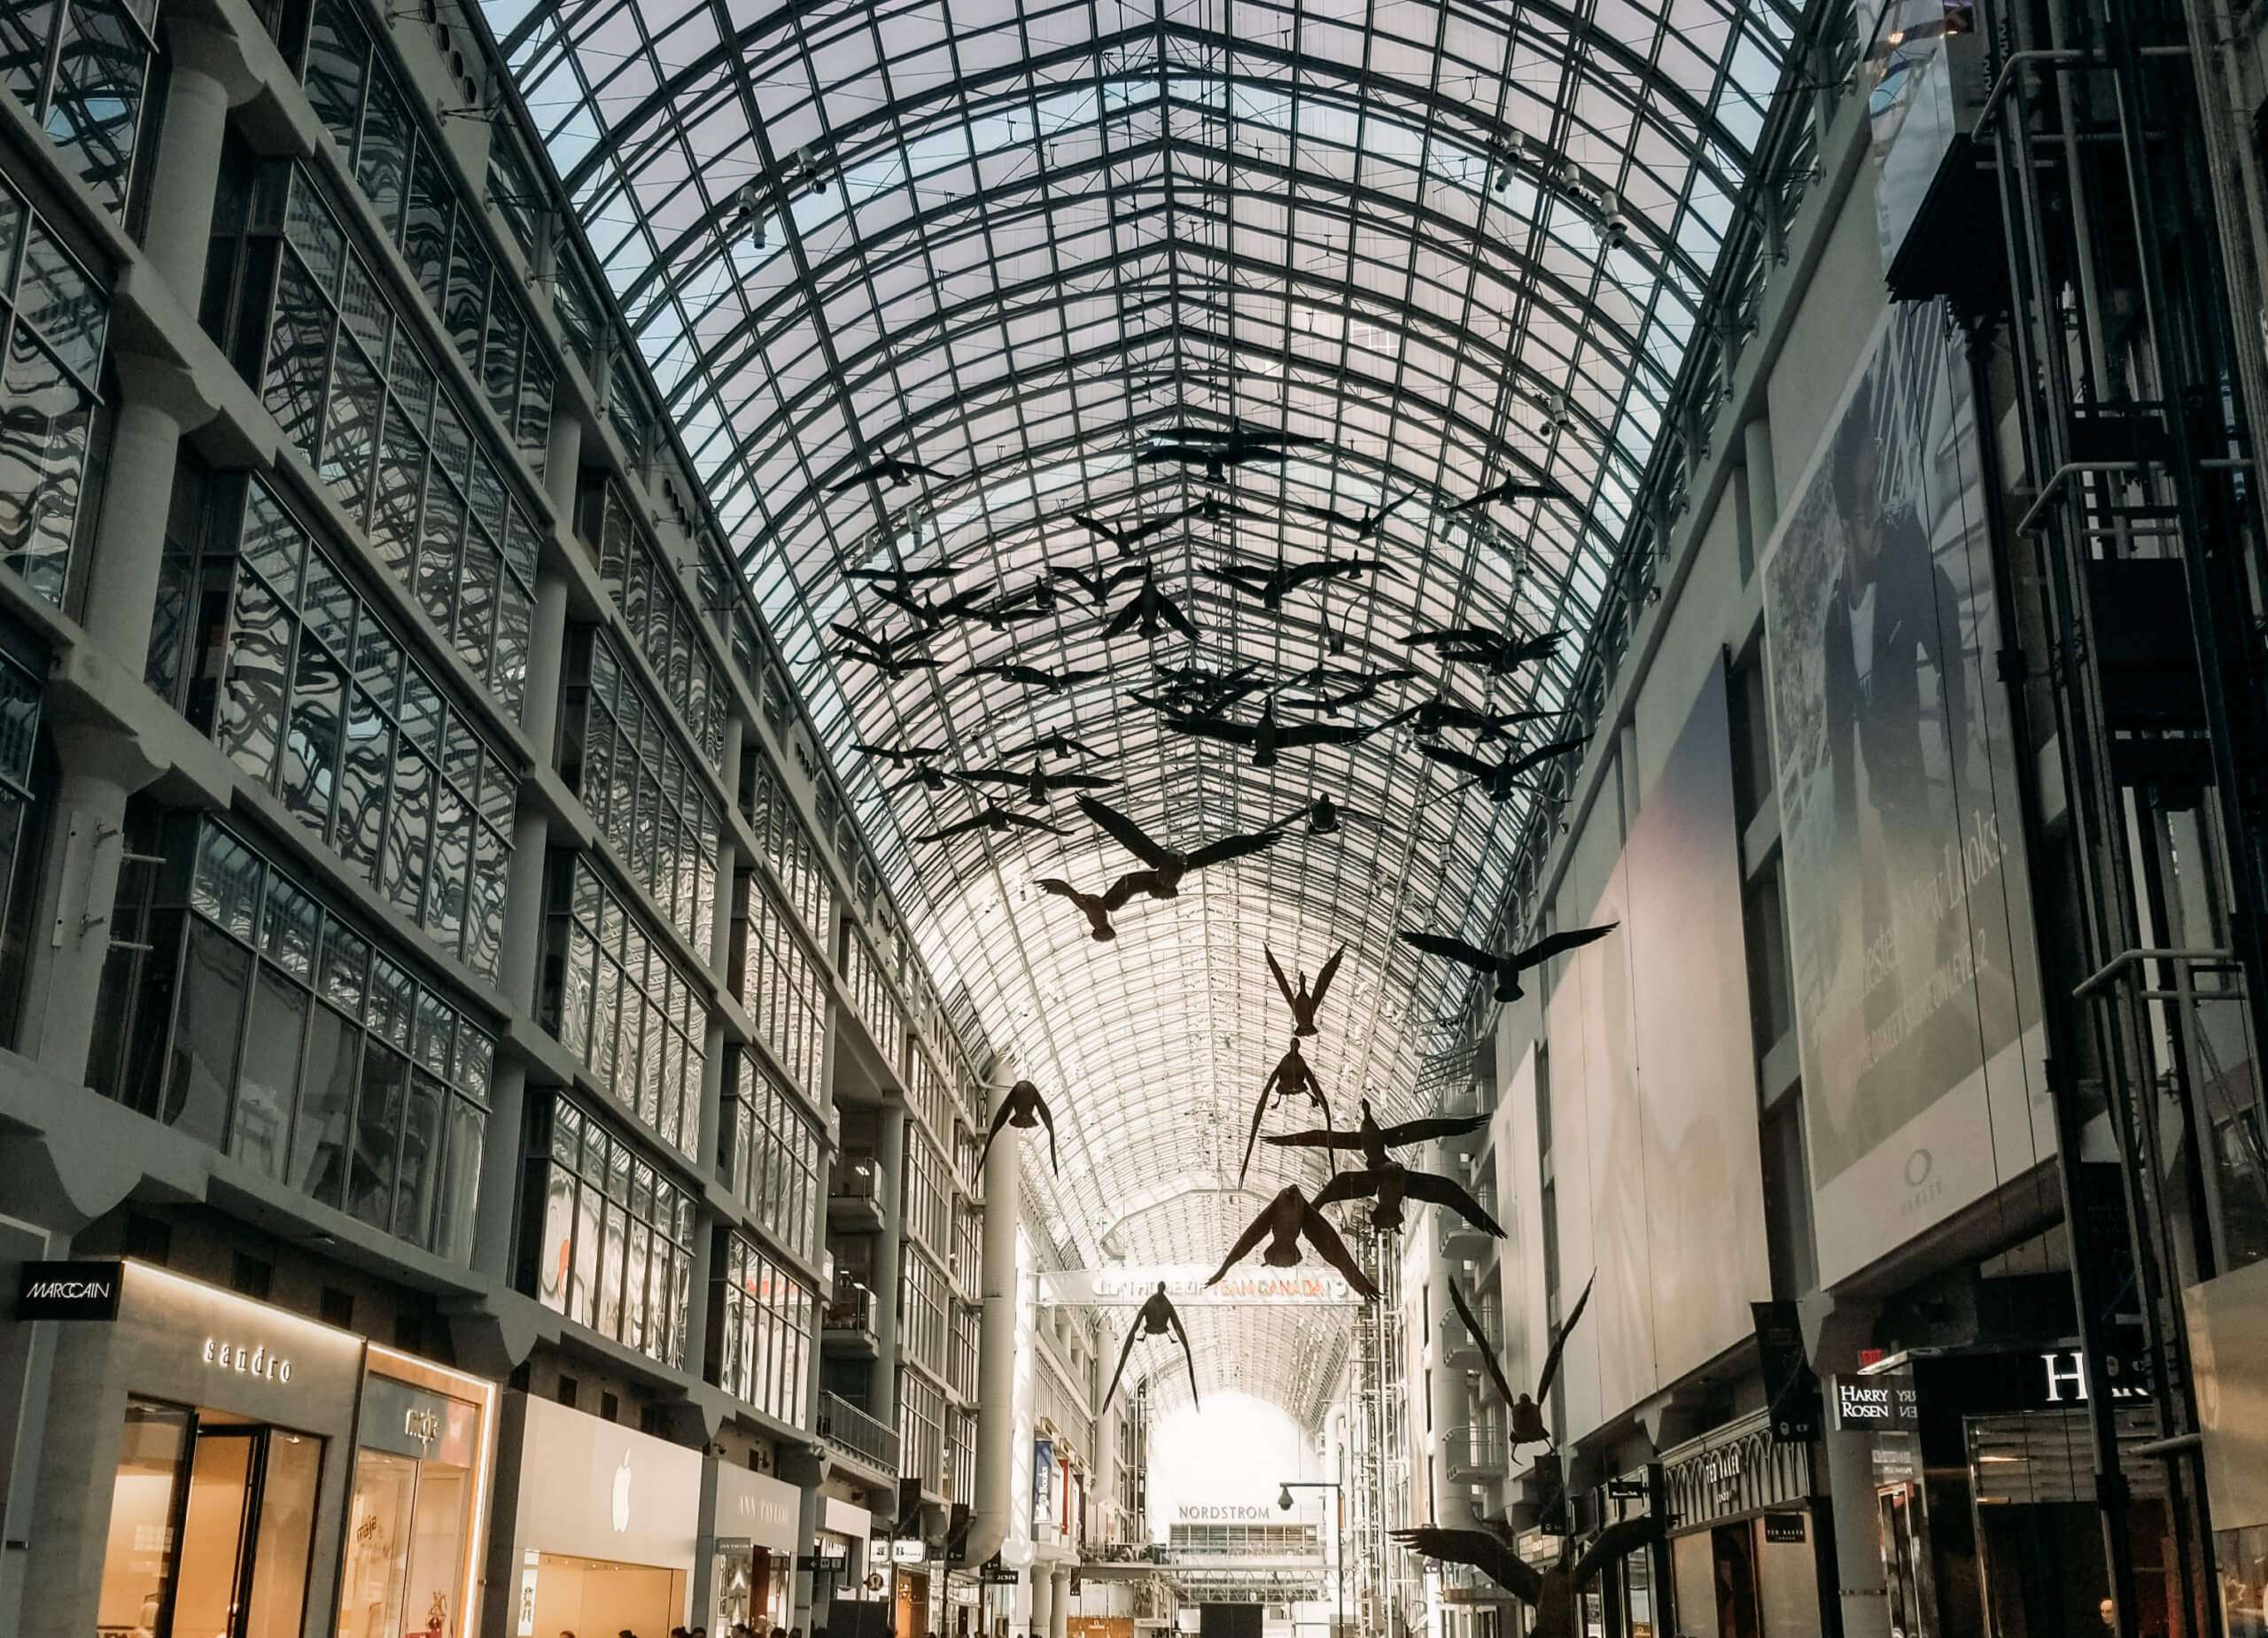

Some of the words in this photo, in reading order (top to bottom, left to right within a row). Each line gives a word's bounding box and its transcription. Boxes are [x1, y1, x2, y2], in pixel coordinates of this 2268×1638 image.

[1257, 1279, 1326, 1297] CANADA
[204, 1339, 292, 1383] sandro
[1841, 1386, 1888, 1402] HARRY
[1842, 1402, 1889, 1417] ROSEN
[1178, 1505, 1270, 1519] NORDSTROM
